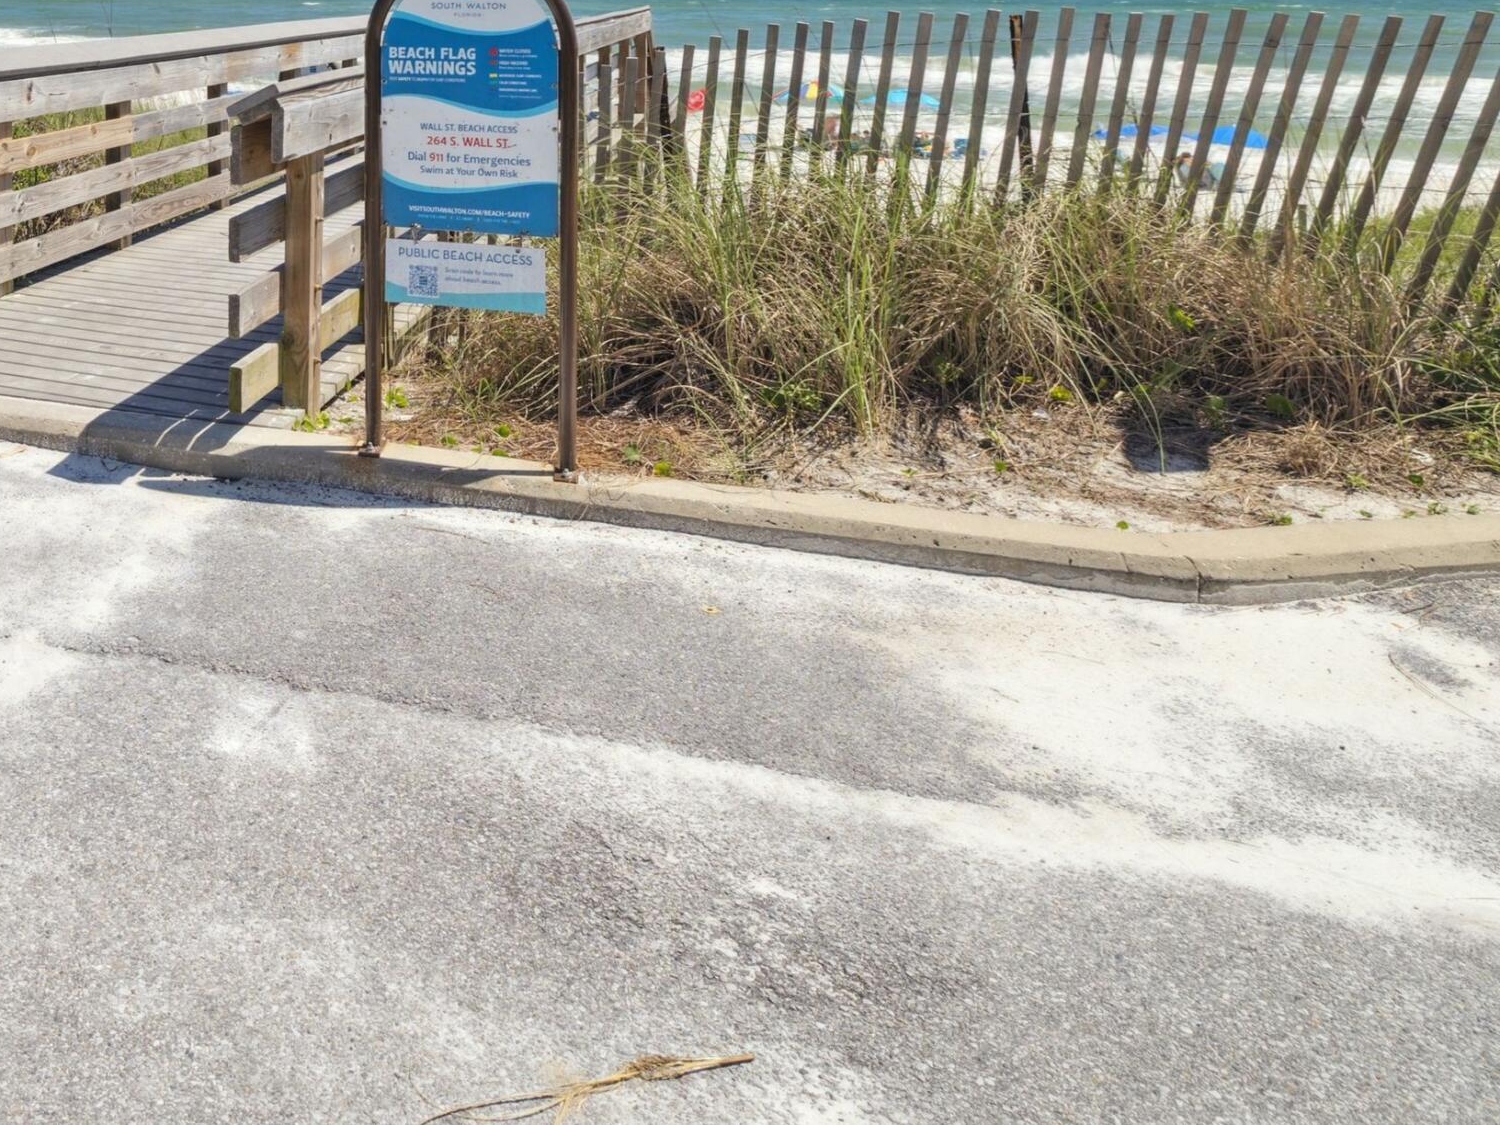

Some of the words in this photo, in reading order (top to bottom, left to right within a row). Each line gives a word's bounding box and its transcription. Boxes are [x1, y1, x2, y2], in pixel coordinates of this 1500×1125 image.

[431, 2, 461, 10] SOUTH
[467, 2, 506, 10] WALTON
[389, 46, 435, 59] BEACH
[440, 47, 476, 60] FLAG
[388, 60, 476, 75] WARNINGS
[420, 123, 442, 131] WALL
[444, 124, 455, 132] ST.
[457, 124, 485, 133] BEACH
[487, 124, 518, 134] ACCESS
[427, 136, 447, 146] 264
[449, 136, 460, 147] S.
[462, 137, 493, 148] WALL
[495, 138, 511, 149] ST.
[408, 151, 427, 161] Dial
[429, 152, 444, 162] 911
[446, 153, 461, 163] for
[463, 154, 531, 168] Emergencies
[420, 165, 444, 174] Swim
[456, 167, 476, 176] Your
[477, 168, 498, 177] Own
[500, 169, 518, 178] Risk
[408, 204, 530, 219] VISITSOUTHWALTON.COM/BEACH-SAFETY
[398, 246, 440, 259] PUBLIC
[442, 249, 483, 262] BEACH
[486, 252, 533, 266] ACCESS
